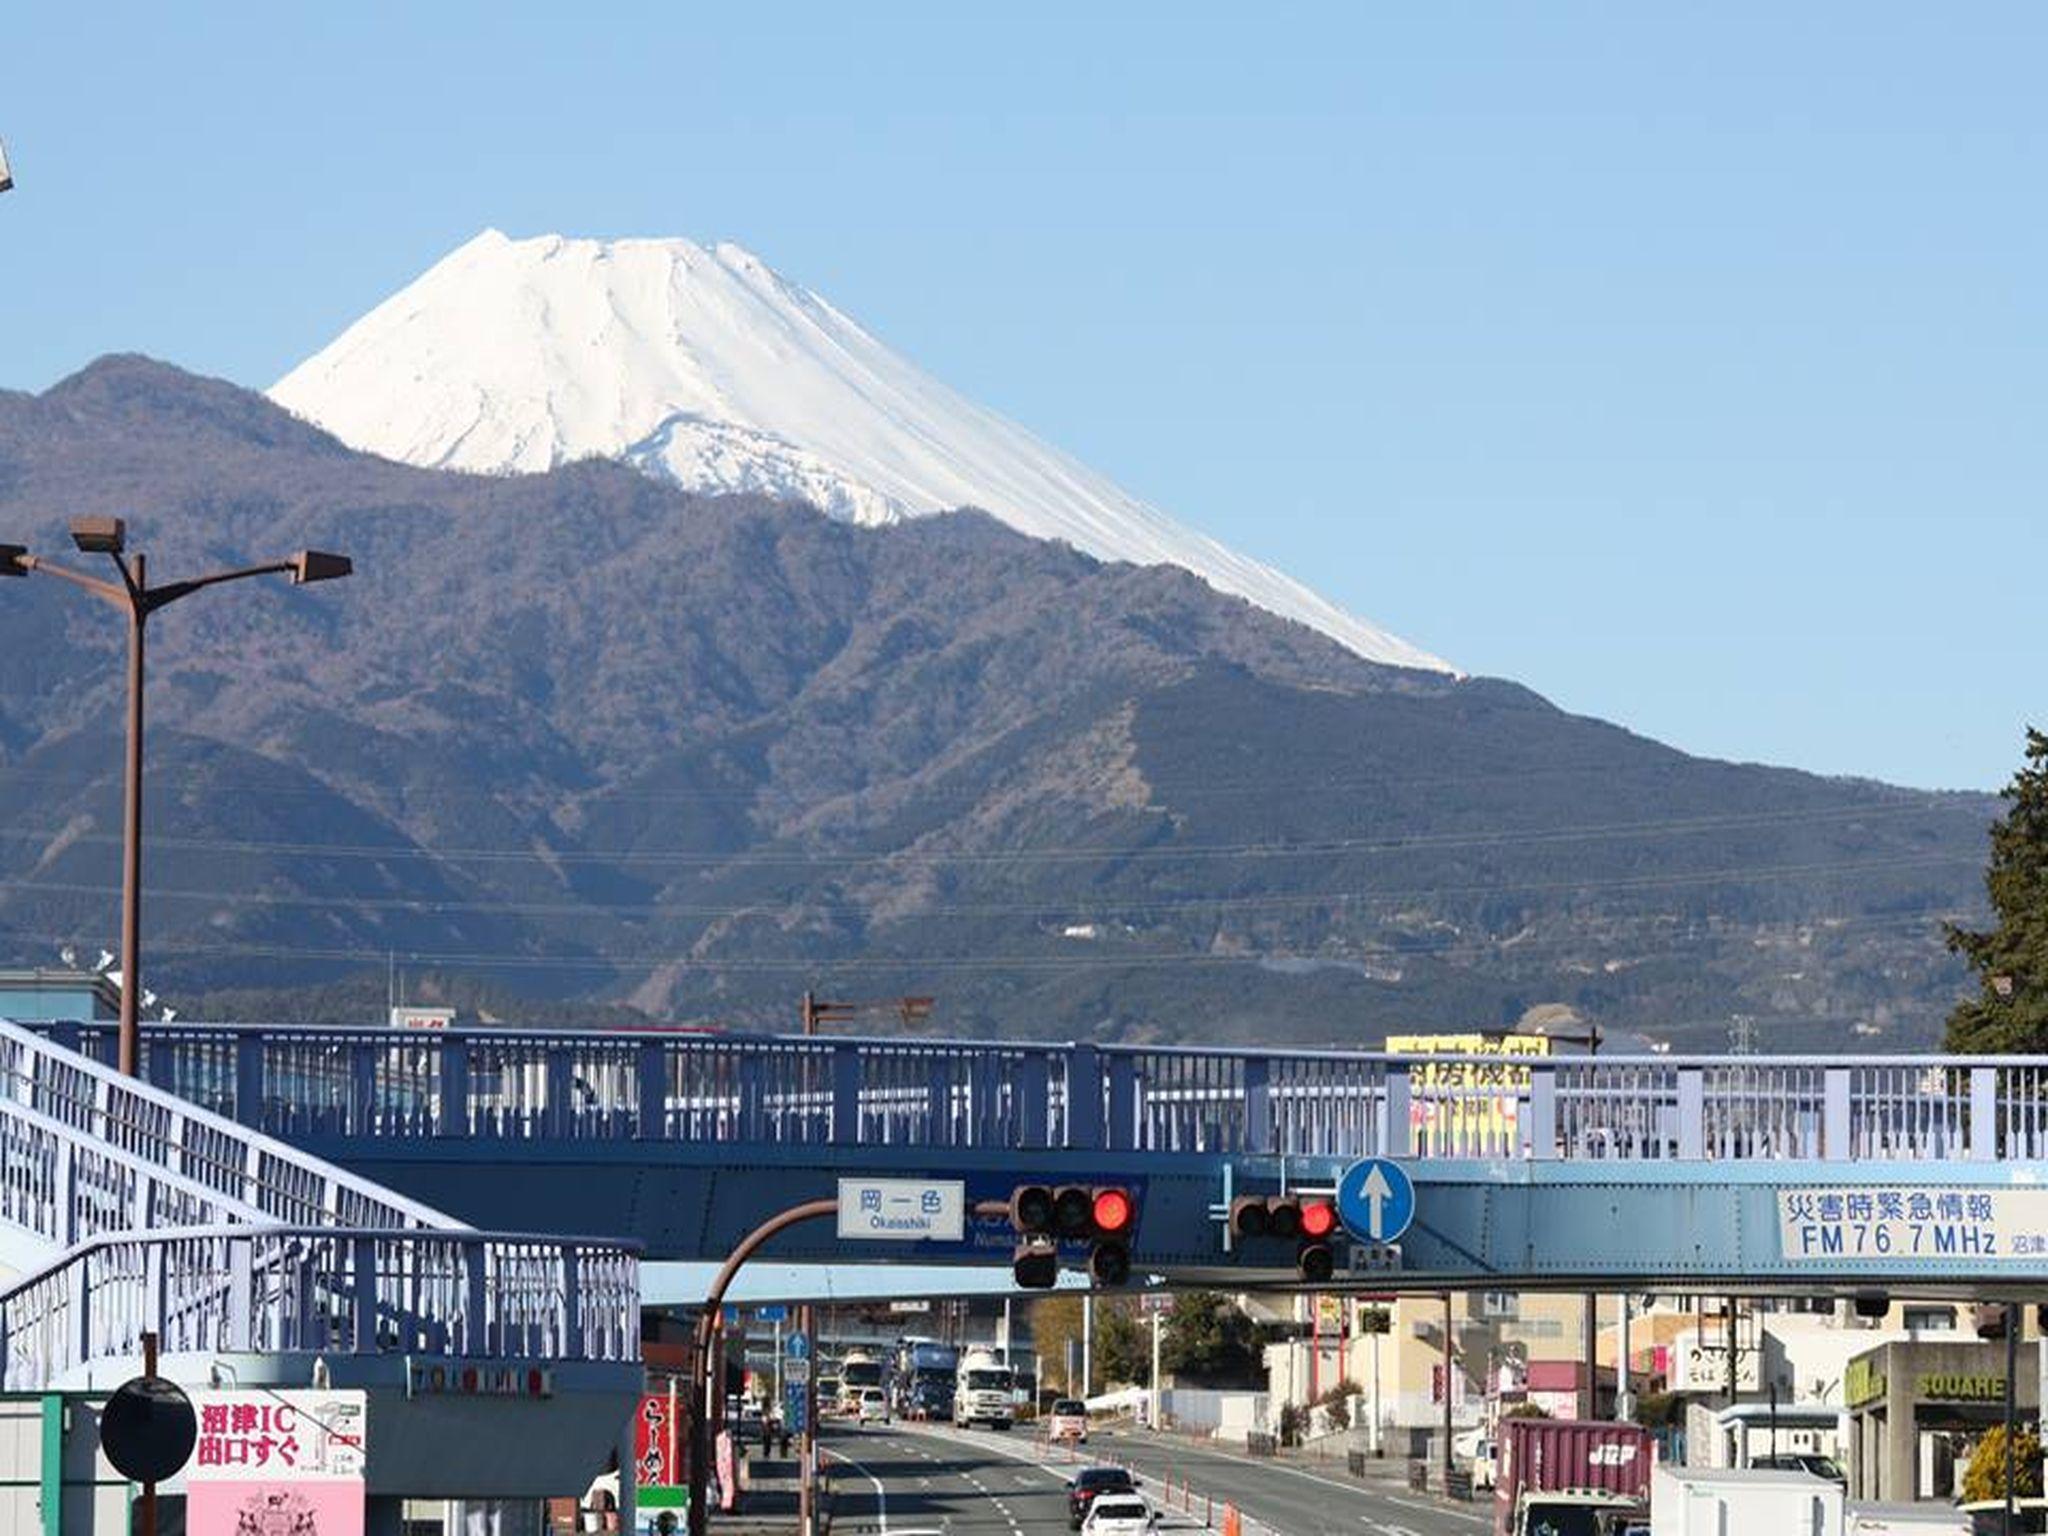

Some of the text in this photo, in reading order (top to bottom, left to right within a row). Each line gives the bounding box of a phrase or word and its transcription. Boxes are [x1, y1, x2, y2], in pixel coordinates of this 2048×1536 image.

[861, 1189, 942, 1213] 岡一色
[1787, 1192, 1994, 1222] 災害時緊急情報
[201, 1403, 297, 1434] 沼津IC
[197, 1435, 300, 1468] 出口すぐ
